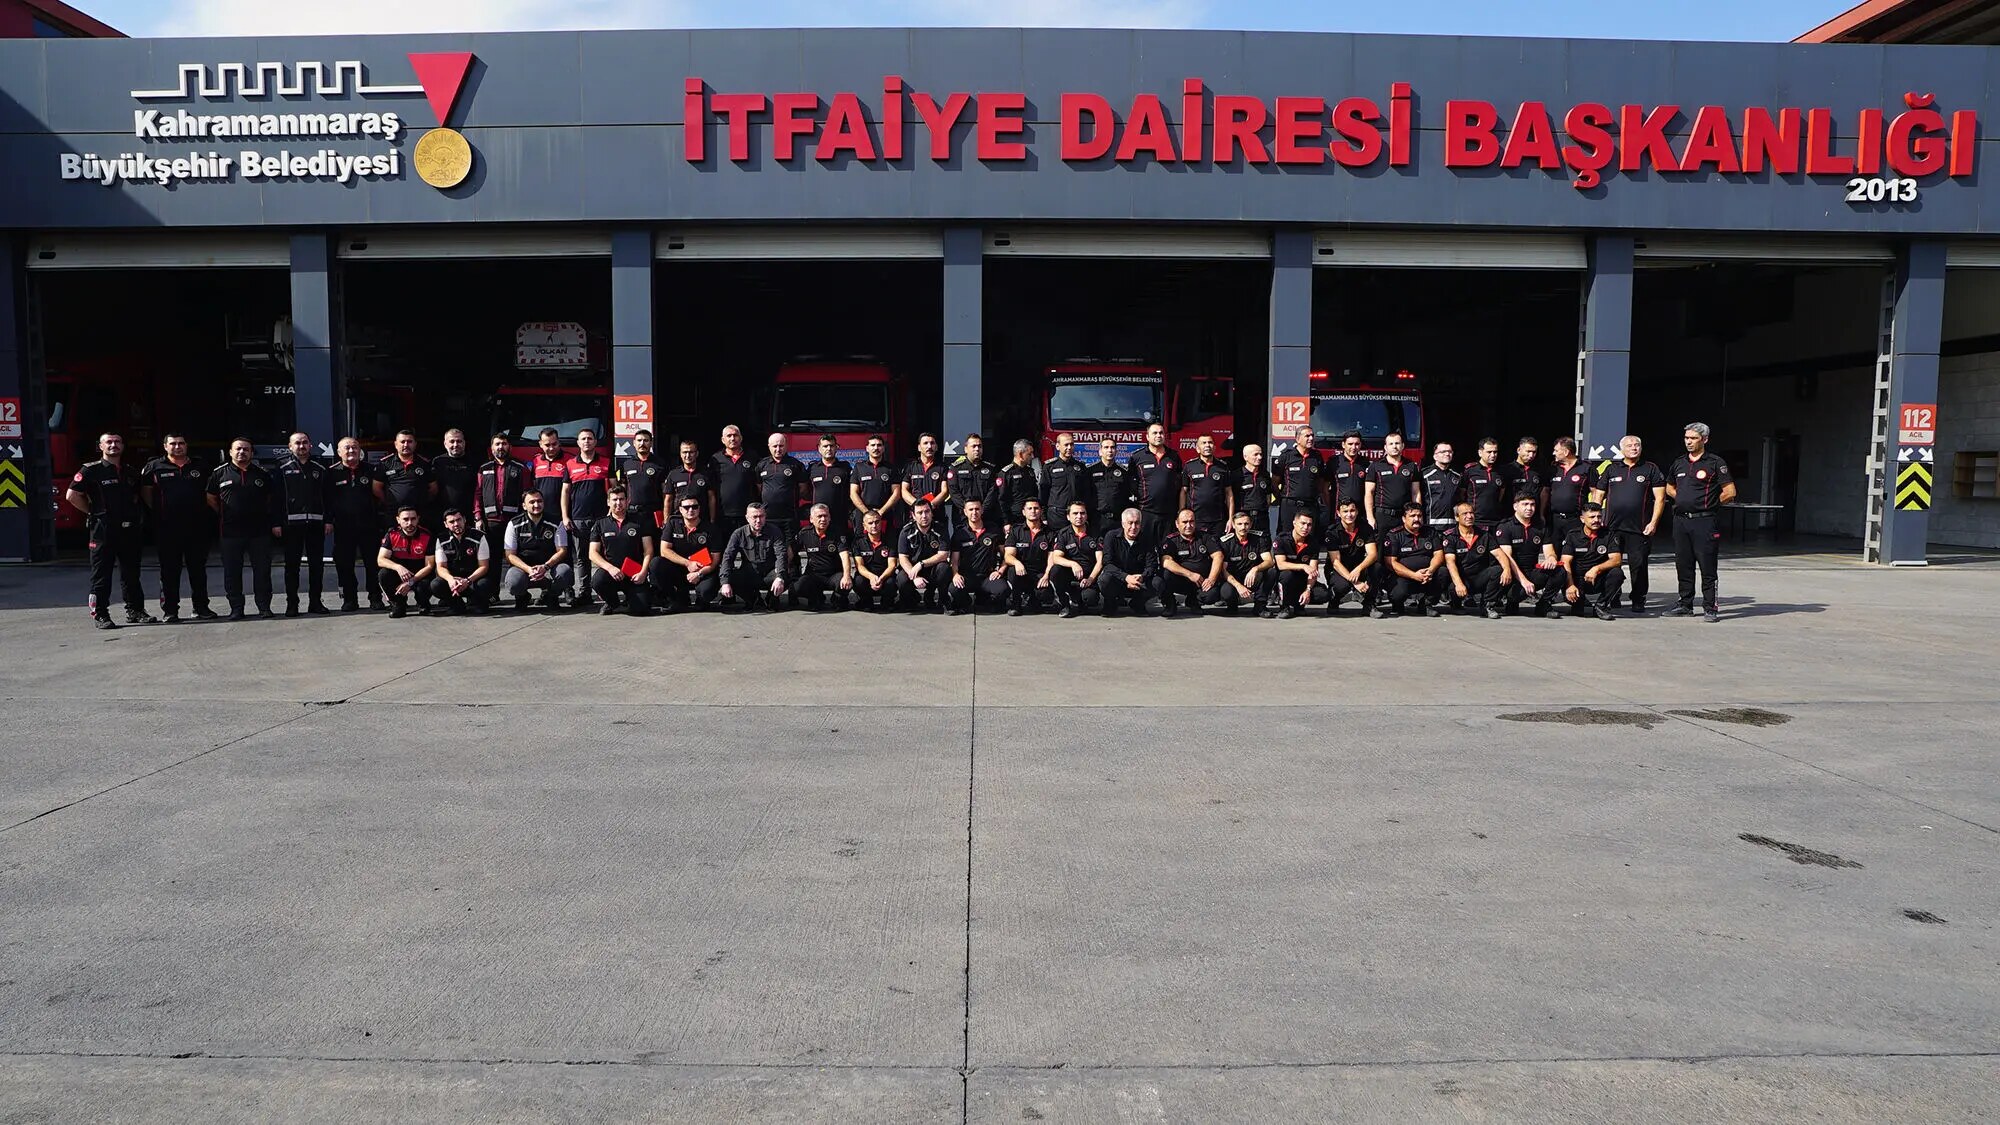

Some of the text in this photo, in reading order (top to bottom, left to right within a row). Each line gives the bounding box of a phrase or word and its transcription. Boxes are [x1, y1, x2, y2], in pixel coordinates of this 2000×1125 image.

[134, 109, 400, 141] Kahramanmaraş
[684, 75, 1977, 190] İTFAİYE DAİRESİ BAŞKANLIĞI
[60, 148, 399, 186] Büyükşehir Belediyesi
[1845, 178, 1918, 202] 2013
[535, 347, 568, 355] VOLKAN
[0, 402, 17, 422] 12
[618, 399, 649, 420] 112
[1276, 401, 1306, 422] 112
[1903, 408, 1932, 428] 112
